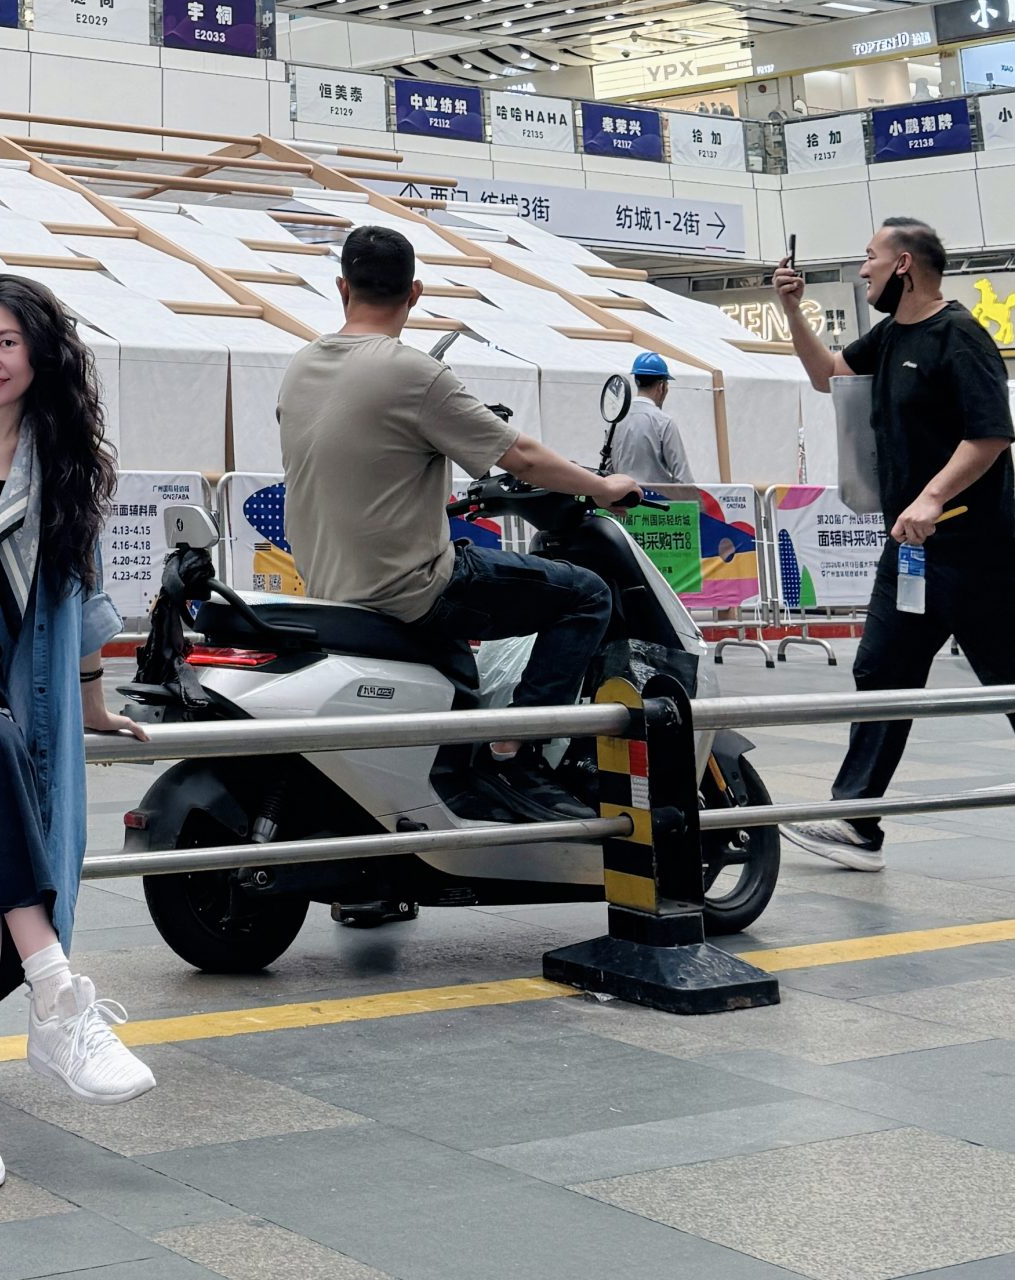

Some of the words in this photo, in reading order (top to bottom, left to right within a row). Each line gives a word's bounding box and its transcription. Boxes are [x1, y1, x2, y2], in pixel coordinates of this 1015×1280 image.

[76, 13, 108, 26] E2029
[187, 2, 233, 26] 宇桐
[194, 28, 226, 42] E2033
[647, 60, 697, 82] YPX
[319, 83, 363, 102] 恒美泰
[410, 93, 468, 116] 中业纺织
[330, 106, 353, 117] F2129
[429, 117, 450, 129] F2112
[523, 128, 544, 139] F2135
[909, 137, 934, 149] F2138
[699, 149, 718, 159] F2137
[814, 151, 836, 161] F2137
[615, 205, 701, 237] 纺城1-2街
[112, 525, 151, 535] 4.13-4.15
[112, 541, 151, 550] 4.16-4.18
[112, 556, 151, 565] 4.20-4.22
[112, 571, 152, 580] 4.23-4.25
